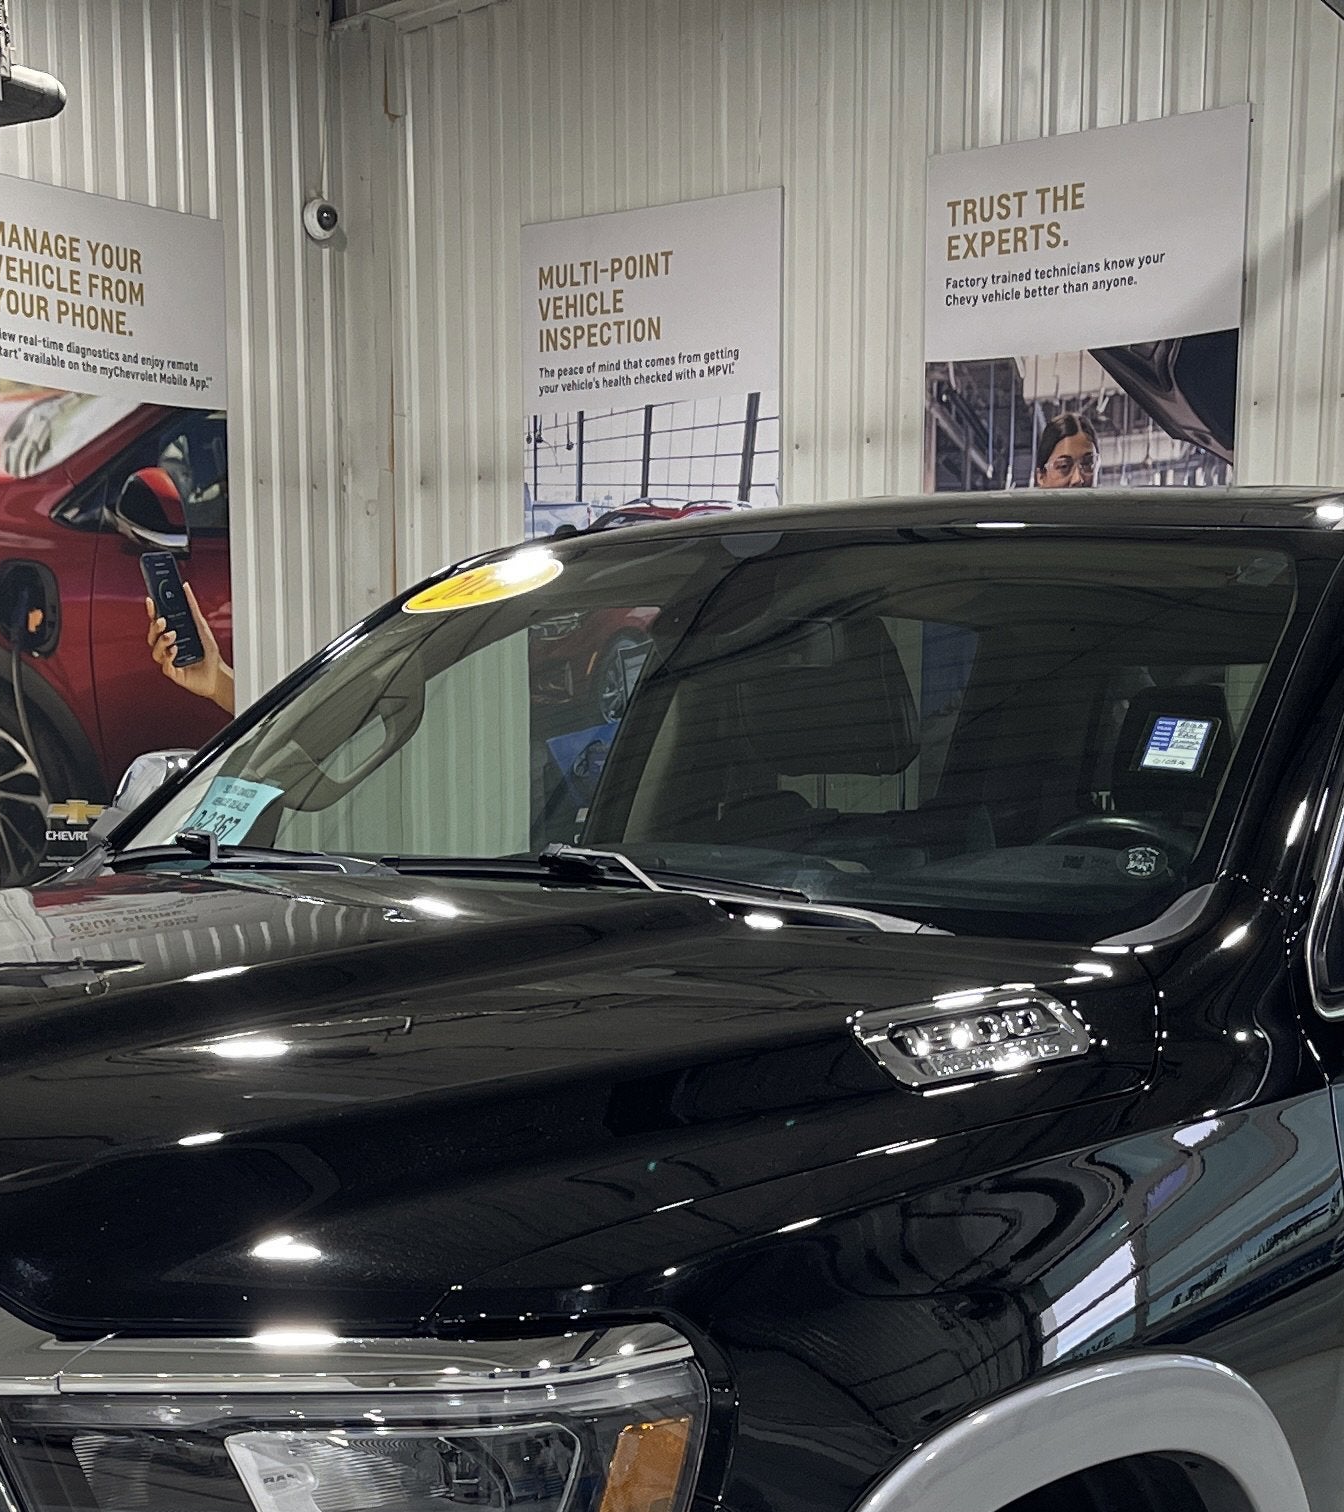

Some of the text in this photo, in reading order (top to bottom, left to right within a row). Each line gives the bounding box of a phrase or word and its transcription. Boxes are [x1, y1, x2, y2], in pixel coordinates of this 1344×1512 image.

[946, 182, 1086, 227] TRUST THE
[87, 240, 142, 274] YOUR
[947, 221, 1069, 262] EXPERTS.
[538, 250, 674, 291] MULTI-POINT
[945, 252, 1166, 290] Factory trained technicians know your
[88, 272, 144, 307] FROM
[538, 289, 624, 321] VEHICLE
[945, 274, 1138, 307] Chevy vehicle better than anyone.
[57, 300, 134, 337] PHONE.
[539, 316, 662, 352] INSPECTION
[18, 334, 64, 352] real-time
[66, 341, 119, 361] diagnostics
[122, 352, 138, 364] and
[141, 355, 164, 370] enjoy
[167, 359, 199, 372] remote
[23, 351, 65, 368] available
[68, 360, 79, 370] on
[82, 361, 97, 374] the
[100, 365, 157, 383] myChevrolet
[160, 372, 187, 386] Mobile
[538, 347, 740, 380] The peace of mind that comes from getting
[538, 384, 558, 397] your
[561, 377, 600, 392] vehicle's
[602, 374, 631, 388] health
[634, 370, 673, 384] checked
[675, 367, 697, 380] with
[45, 830, 88, 841] CHEVR
